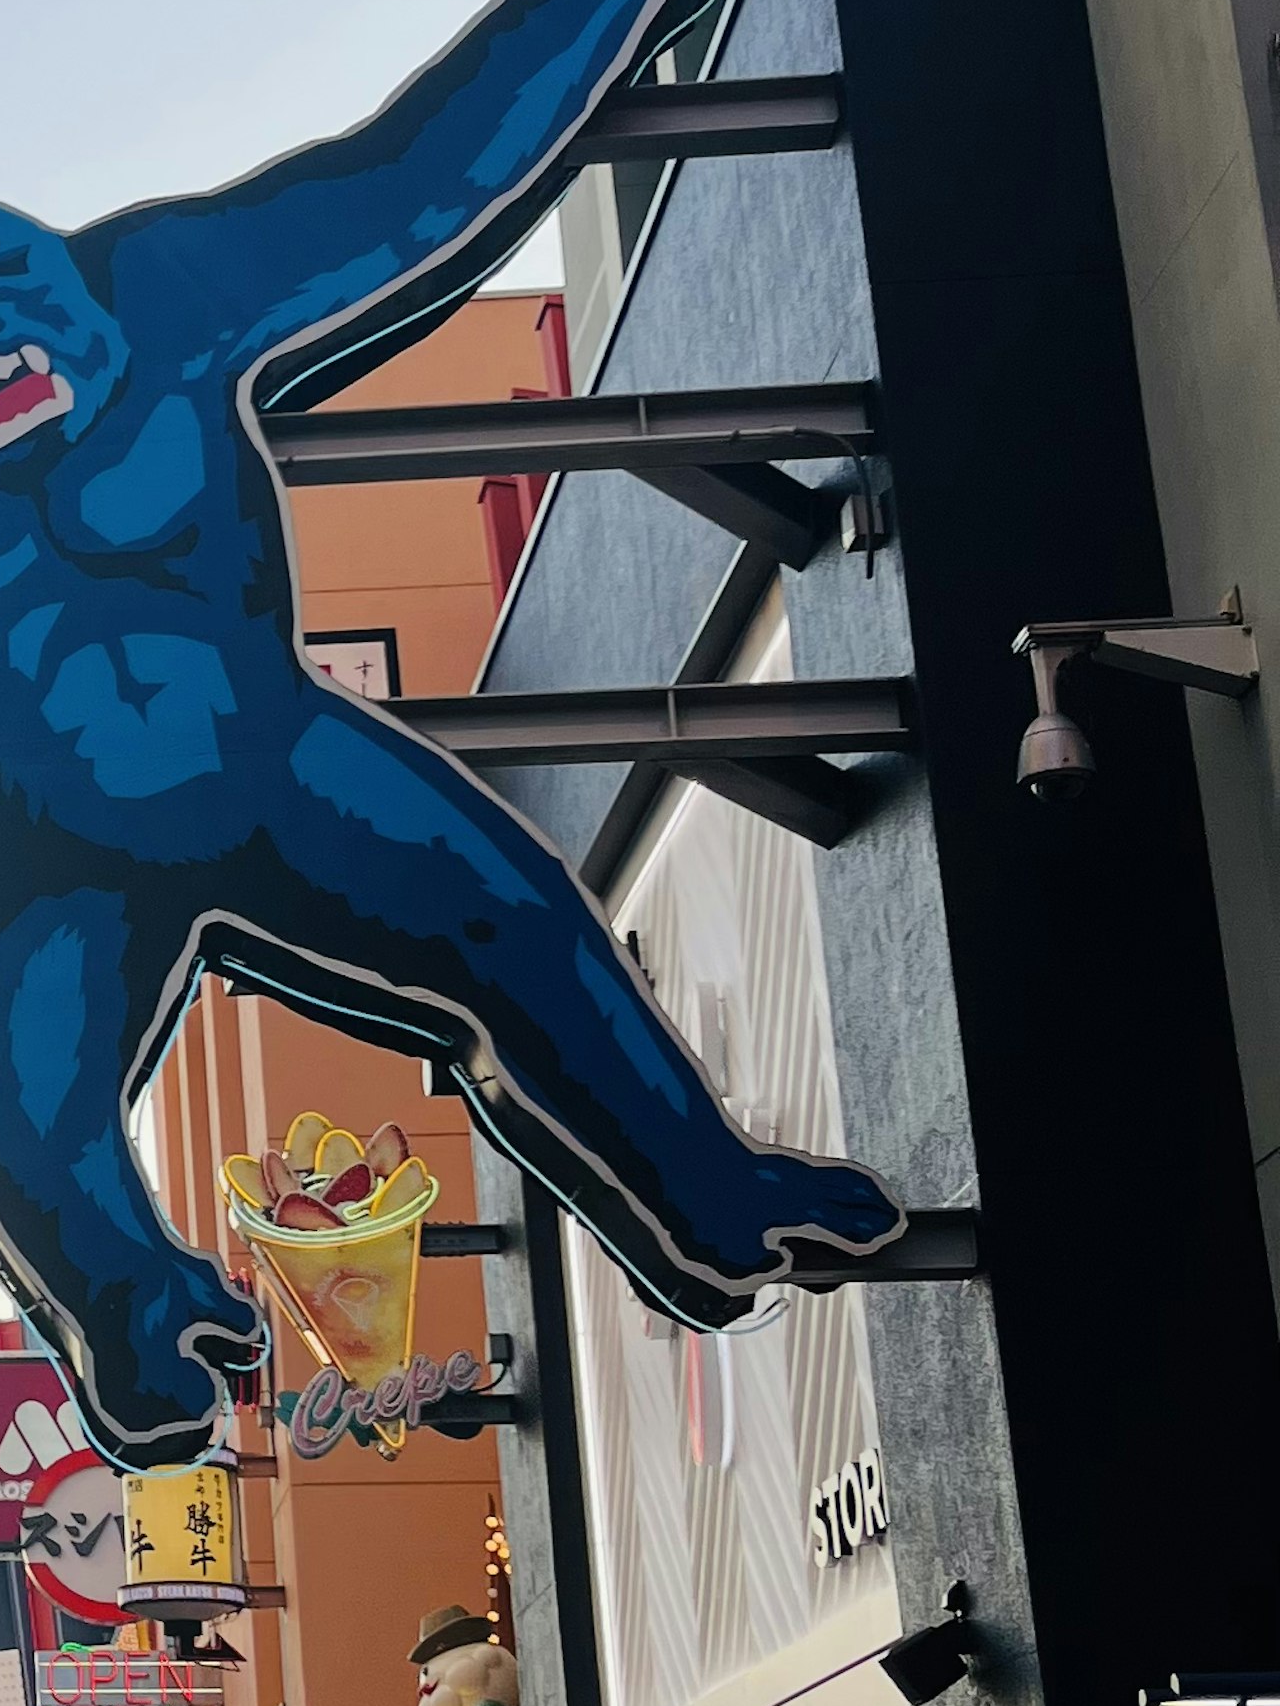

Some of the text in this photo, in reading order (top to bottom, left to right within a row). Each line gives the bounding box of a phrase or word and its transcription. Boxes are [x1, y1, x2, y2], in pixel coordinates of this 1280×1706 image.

[290, 1348, 481, 1459] Crepe
[15, 1511, 126, 1557] スシ
[184, 1500, 218, 1577] 勝牛
[809, 1446, 891, 1568] STOR
[47, 1651, 192, 1705] OPEN
